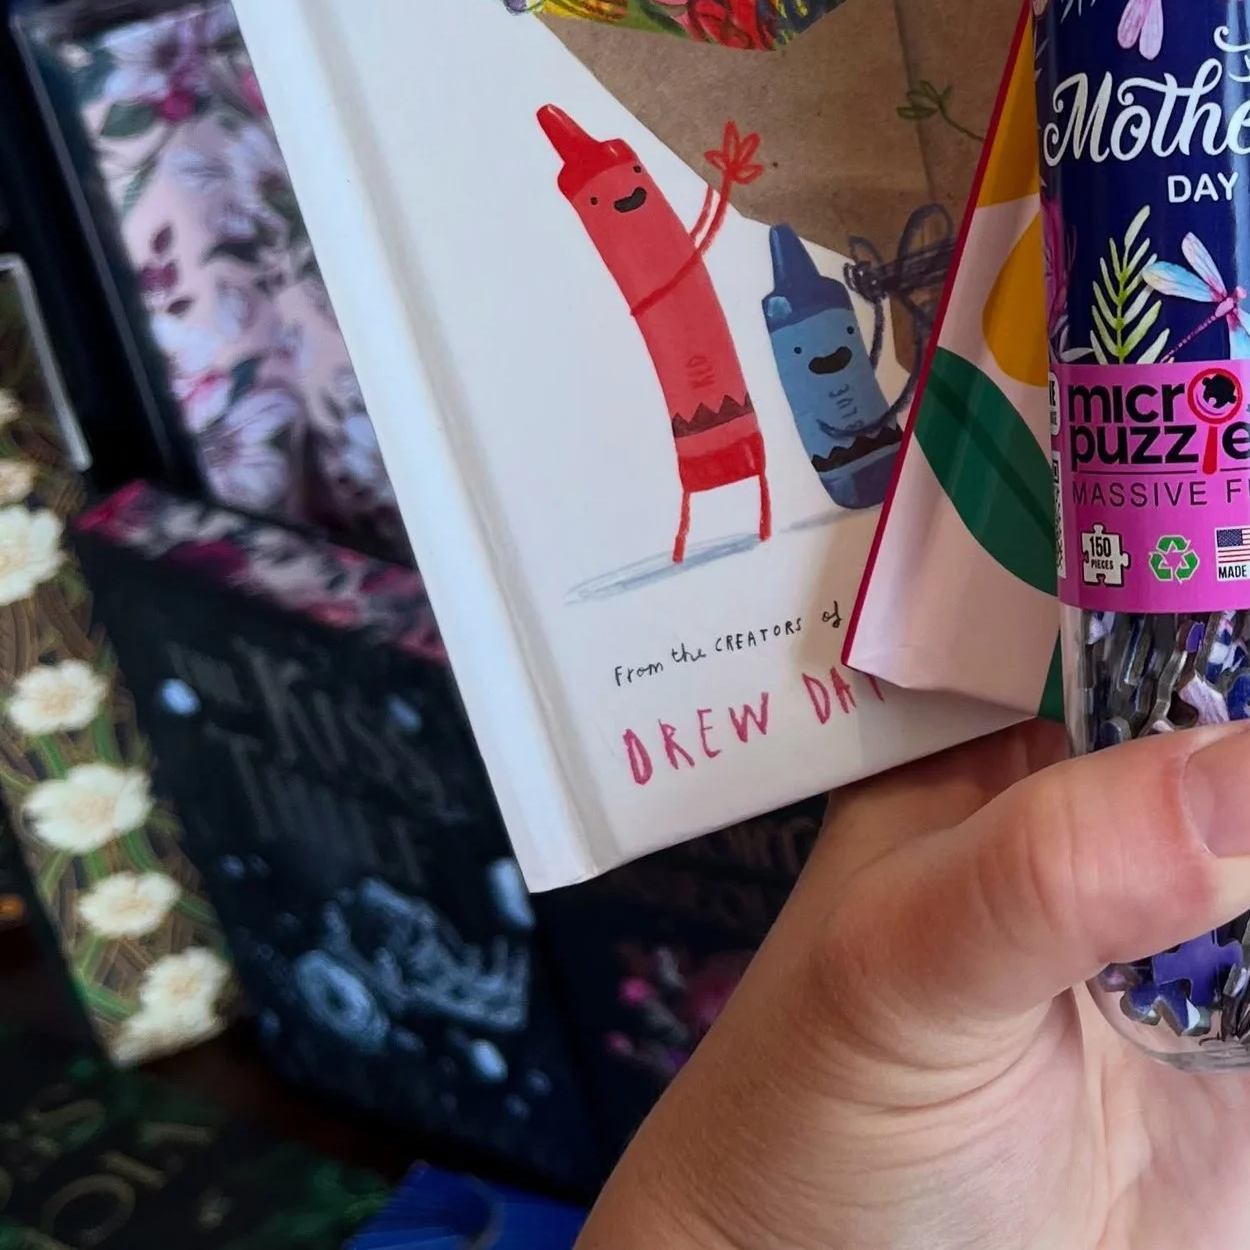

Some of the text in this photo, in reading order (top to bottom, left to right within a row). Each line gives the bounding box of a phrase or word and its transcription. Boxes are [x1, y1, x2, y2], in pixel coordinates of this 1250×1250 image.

[1167, 172, 1239, 203] DAY
[1072, 480, 1208, 507] MASSIVE
[1089, 535, 1112, 557] 150
[1091, 559, 1114, 570] PIECES
[1218, 564, 1247, 579] MADE
[614, 600, 843, 687] From the CREATORS of
[622, 692, 770, 786] DREW
